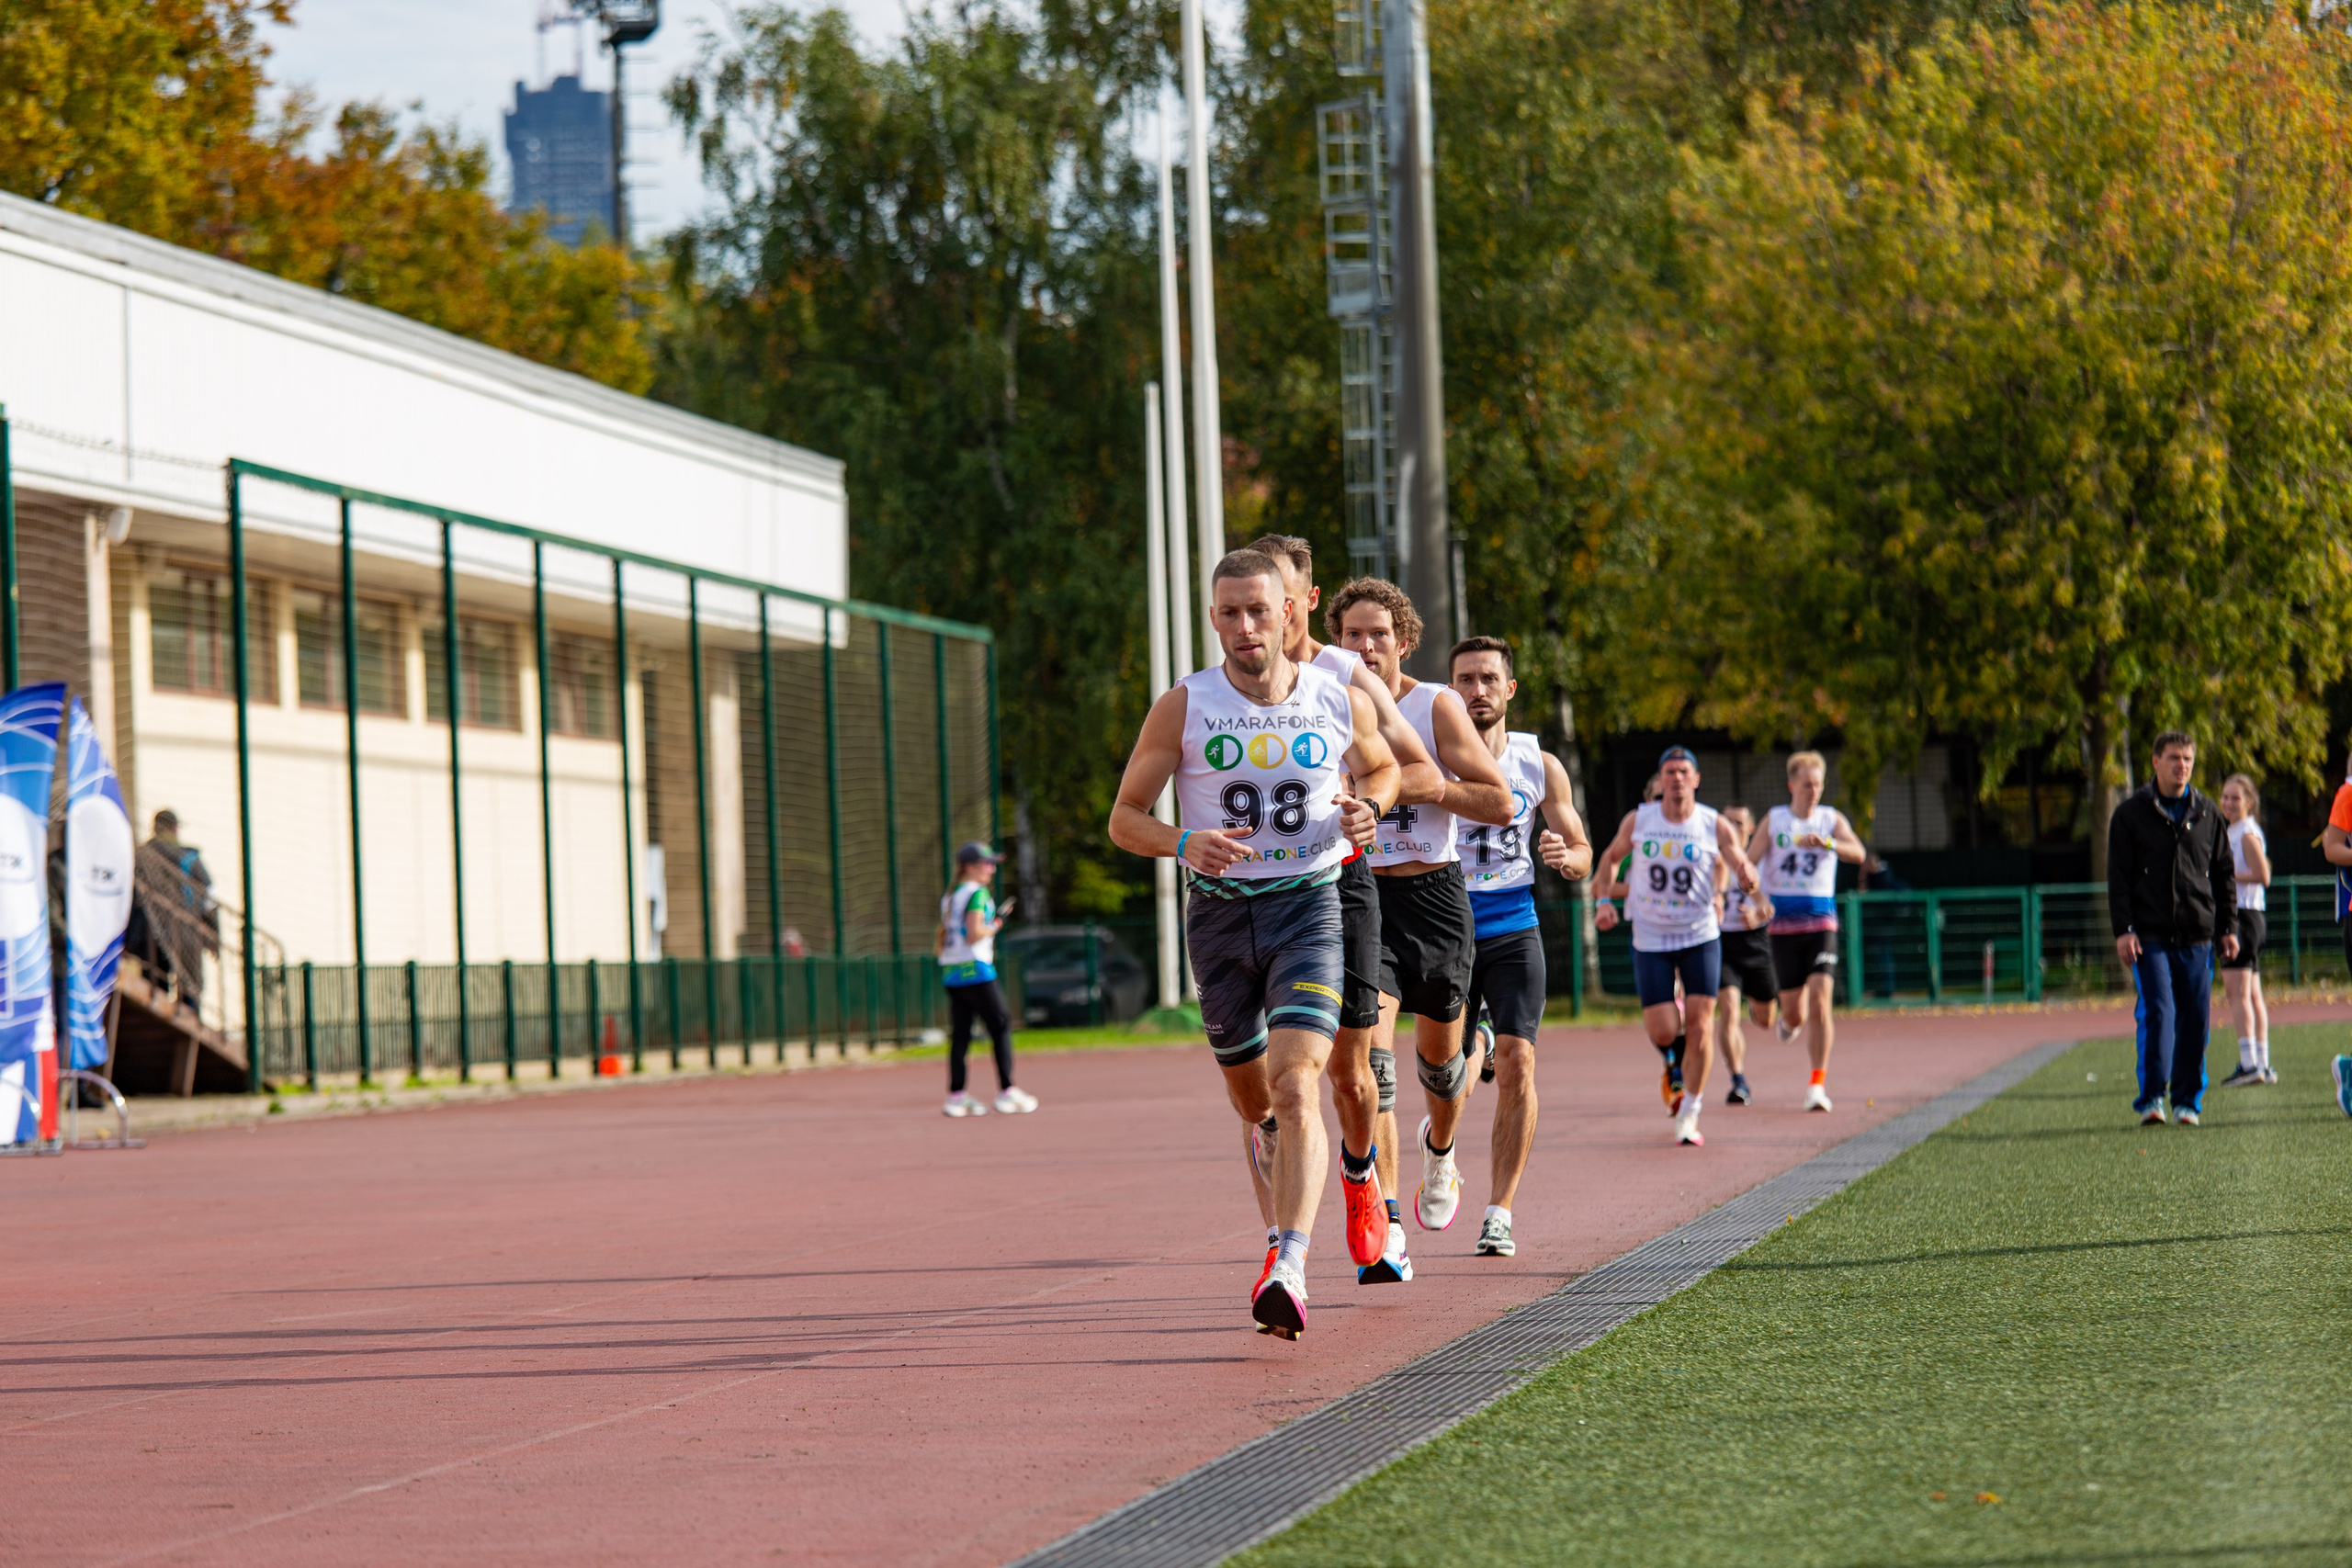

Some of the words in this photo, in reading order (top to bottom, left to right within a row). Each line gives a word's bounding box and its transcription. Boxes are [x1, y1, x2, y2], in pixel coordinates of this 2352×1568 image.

[1204, 716, 1326, 731] VMARAFONE
[1220, 779, 1310, 840] 98
[1377, 805, 1418, 832] 4
[1240, 836, 1336, 863] RAFONE.CLUB
[1363, 841, 1432, 854] ONE.CLUB
[1466, 825, 1523, 866] 19
[1780, 852, 1818, 876] 43
[1650, 863, 1692, 895] 99
